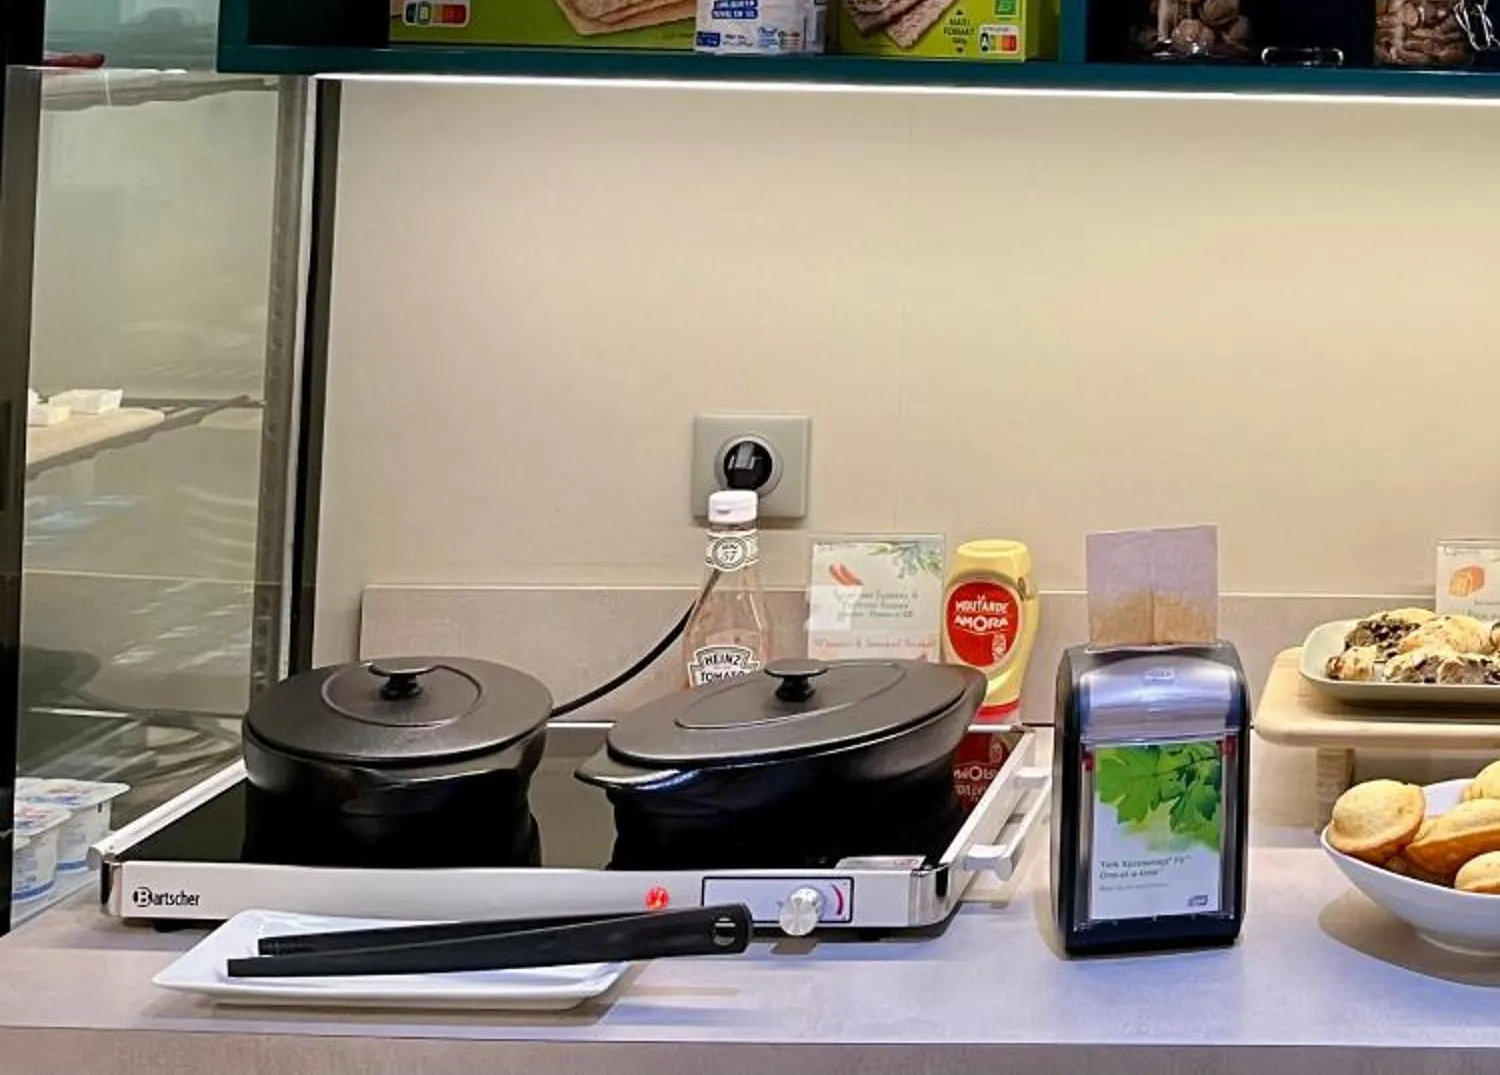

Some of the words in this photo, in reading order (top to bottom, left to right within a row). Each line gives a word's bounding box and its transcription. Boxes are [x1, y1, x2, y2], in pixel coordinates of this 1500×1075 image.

[953, 615, 1009, 632] AMORA
[703, 653, 742, 667] HEINZ
[132, 886, 201, 908] Bartscher
